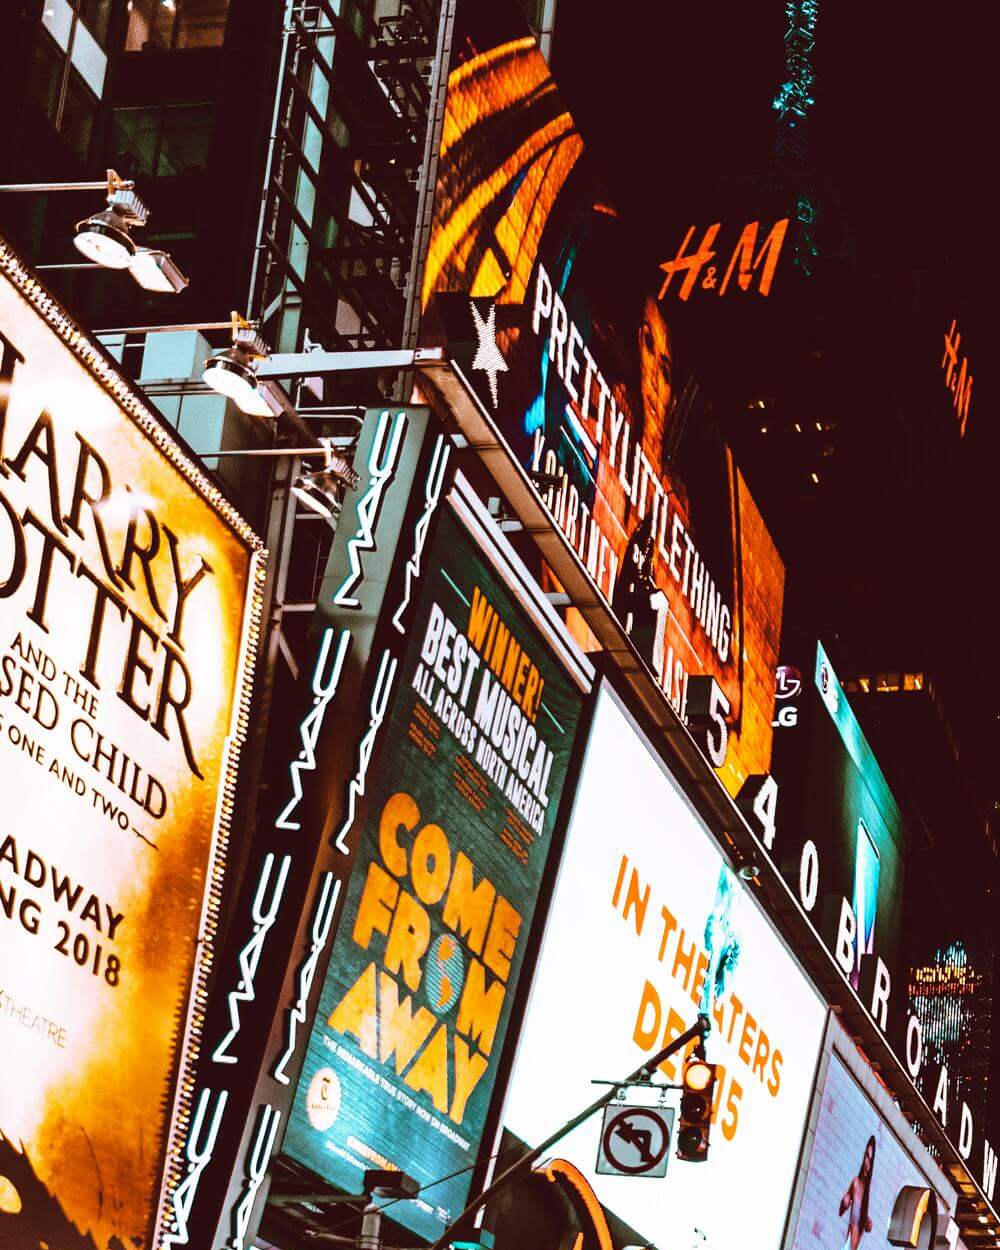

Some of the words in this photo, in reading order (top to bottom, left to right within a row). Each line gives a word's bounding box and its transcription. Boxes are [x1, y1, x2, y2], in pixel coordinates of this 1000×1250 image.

[659, 218, 789, 301] H&M
[532, 262, 732, 663] PRETTYLITTLETHING
[11, 632, 57, 681] AND
[63, 671, 99, 719] THE
[421, 601, 481, 707] BEST
[473, 669, 554, 808] MUSICAL
[467, 585, 544, 723] WINNER!
[8, 725, 45, 765] ONE
[49, 759, 86, 796] AND
[92, 788, 129, 830] TWO
[70, 718, 168, 819] CHILD
[412, 663, 436, 706] ALL
[433, 690, 478, 754] ACROSS
[475, 739, 509, 792] NORTH
[505, 779, 549, 837] AMERICA
[378, 792, 521, 982] COME
[612, 854, 651, 936] IN
[54, 920, 121, 987] 2018
[327, 962, 488, 1125] AWAY
